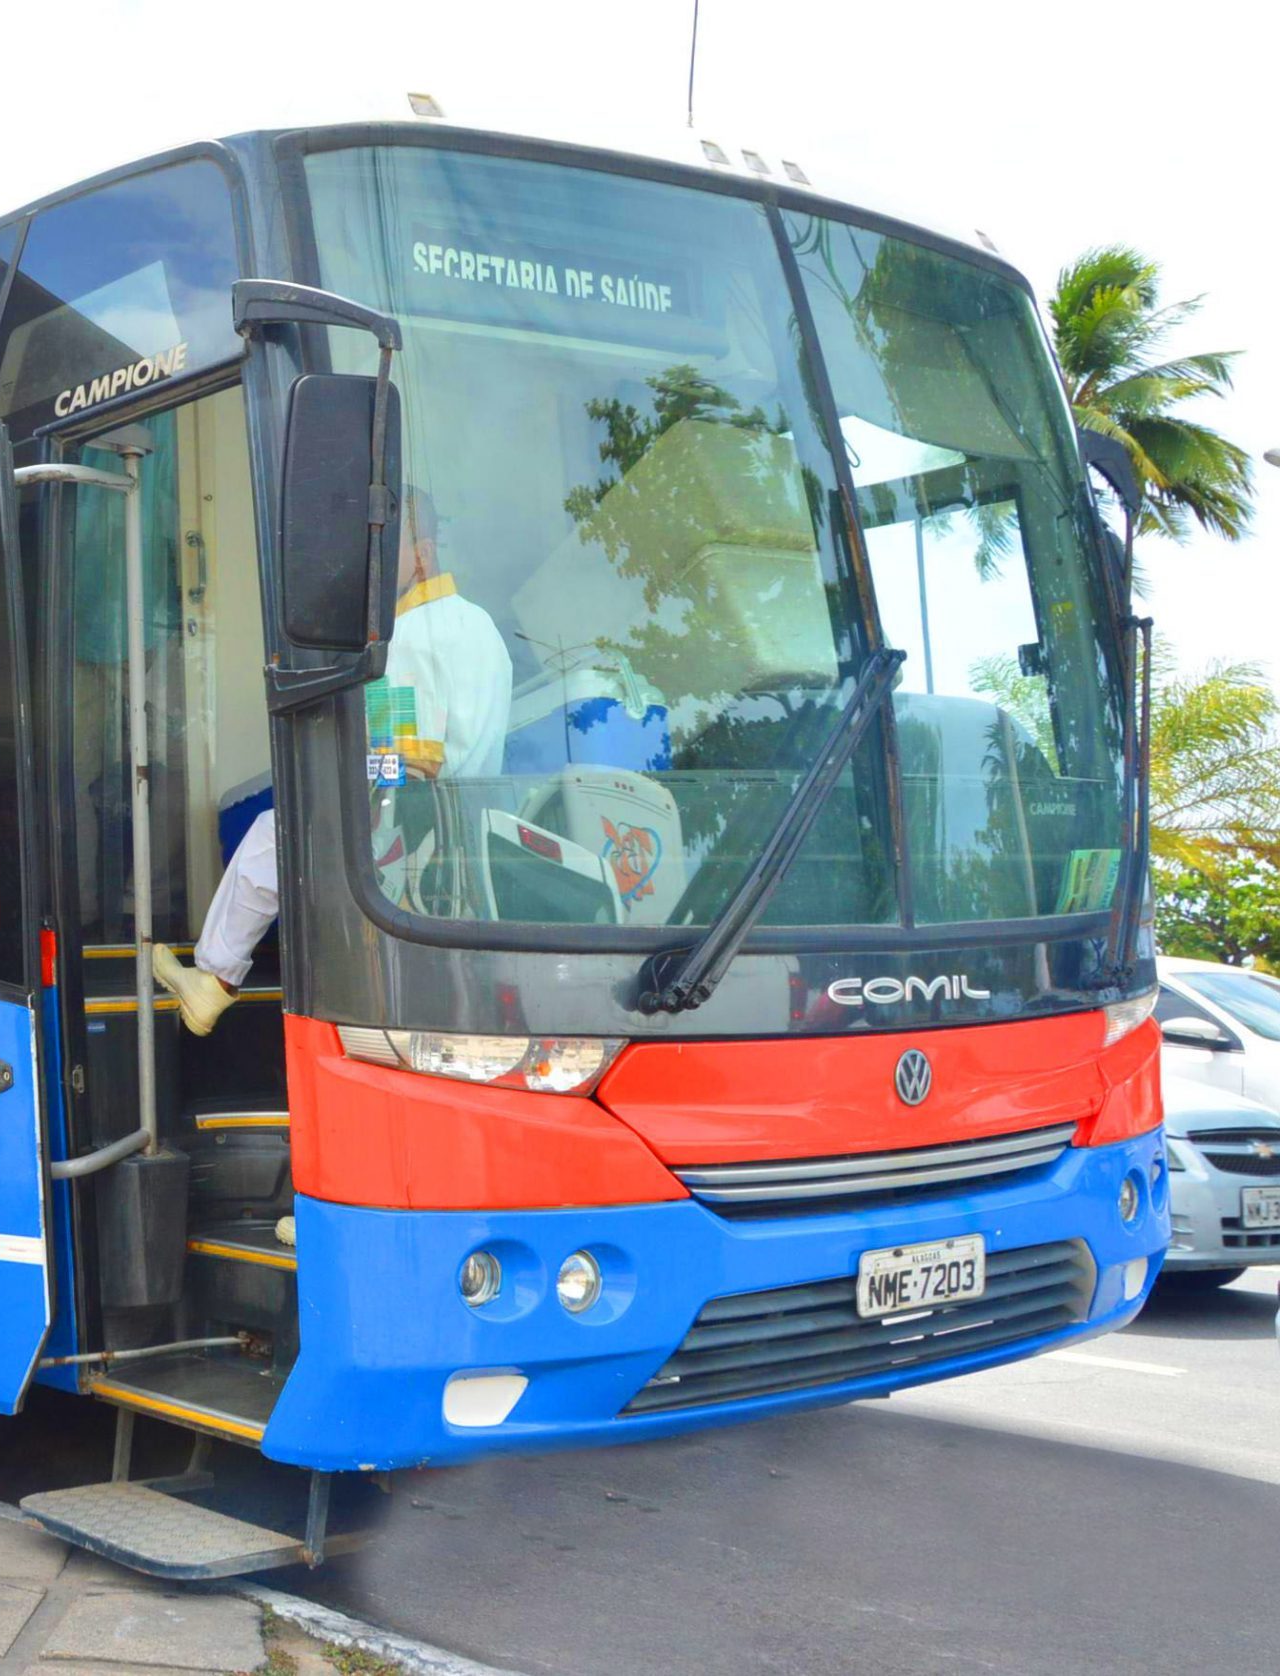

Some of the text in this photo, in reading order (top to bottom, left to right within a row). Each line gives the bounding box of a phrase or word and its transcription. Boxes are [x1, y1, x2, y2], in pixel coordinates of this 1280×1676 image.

[412, 241, 558, 295] SECRETARIA
[565, 267, 594, 300] DE
[54, 341, 190, 418] CAMPIONE
[826, 973, 992, 1006] COMIL
